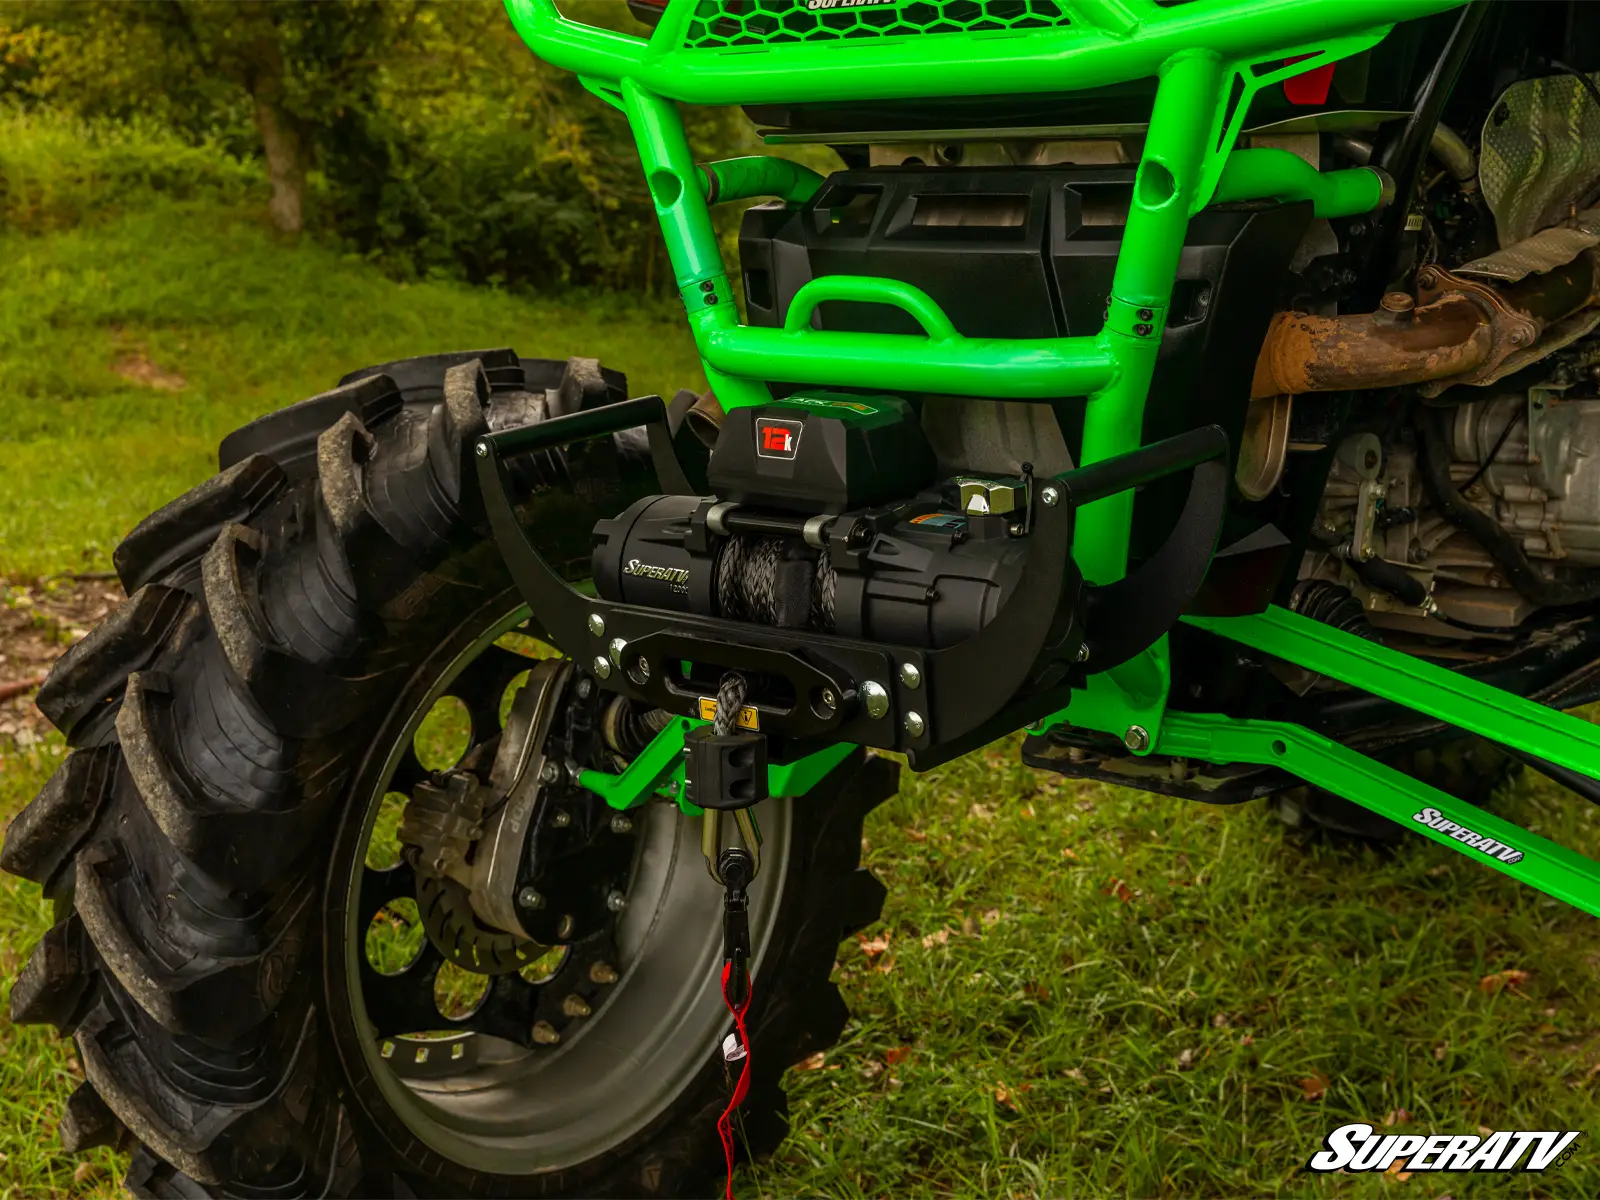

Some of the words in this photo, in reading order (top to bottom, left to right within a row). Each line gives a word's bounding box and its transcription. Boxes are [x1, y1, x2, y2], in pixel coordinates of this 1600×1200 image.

[761, 426, 793, 452] 12k
[623, 559, 689, 583] SUPERATV
[1412, 807, 1523, 862] SUPERATV
